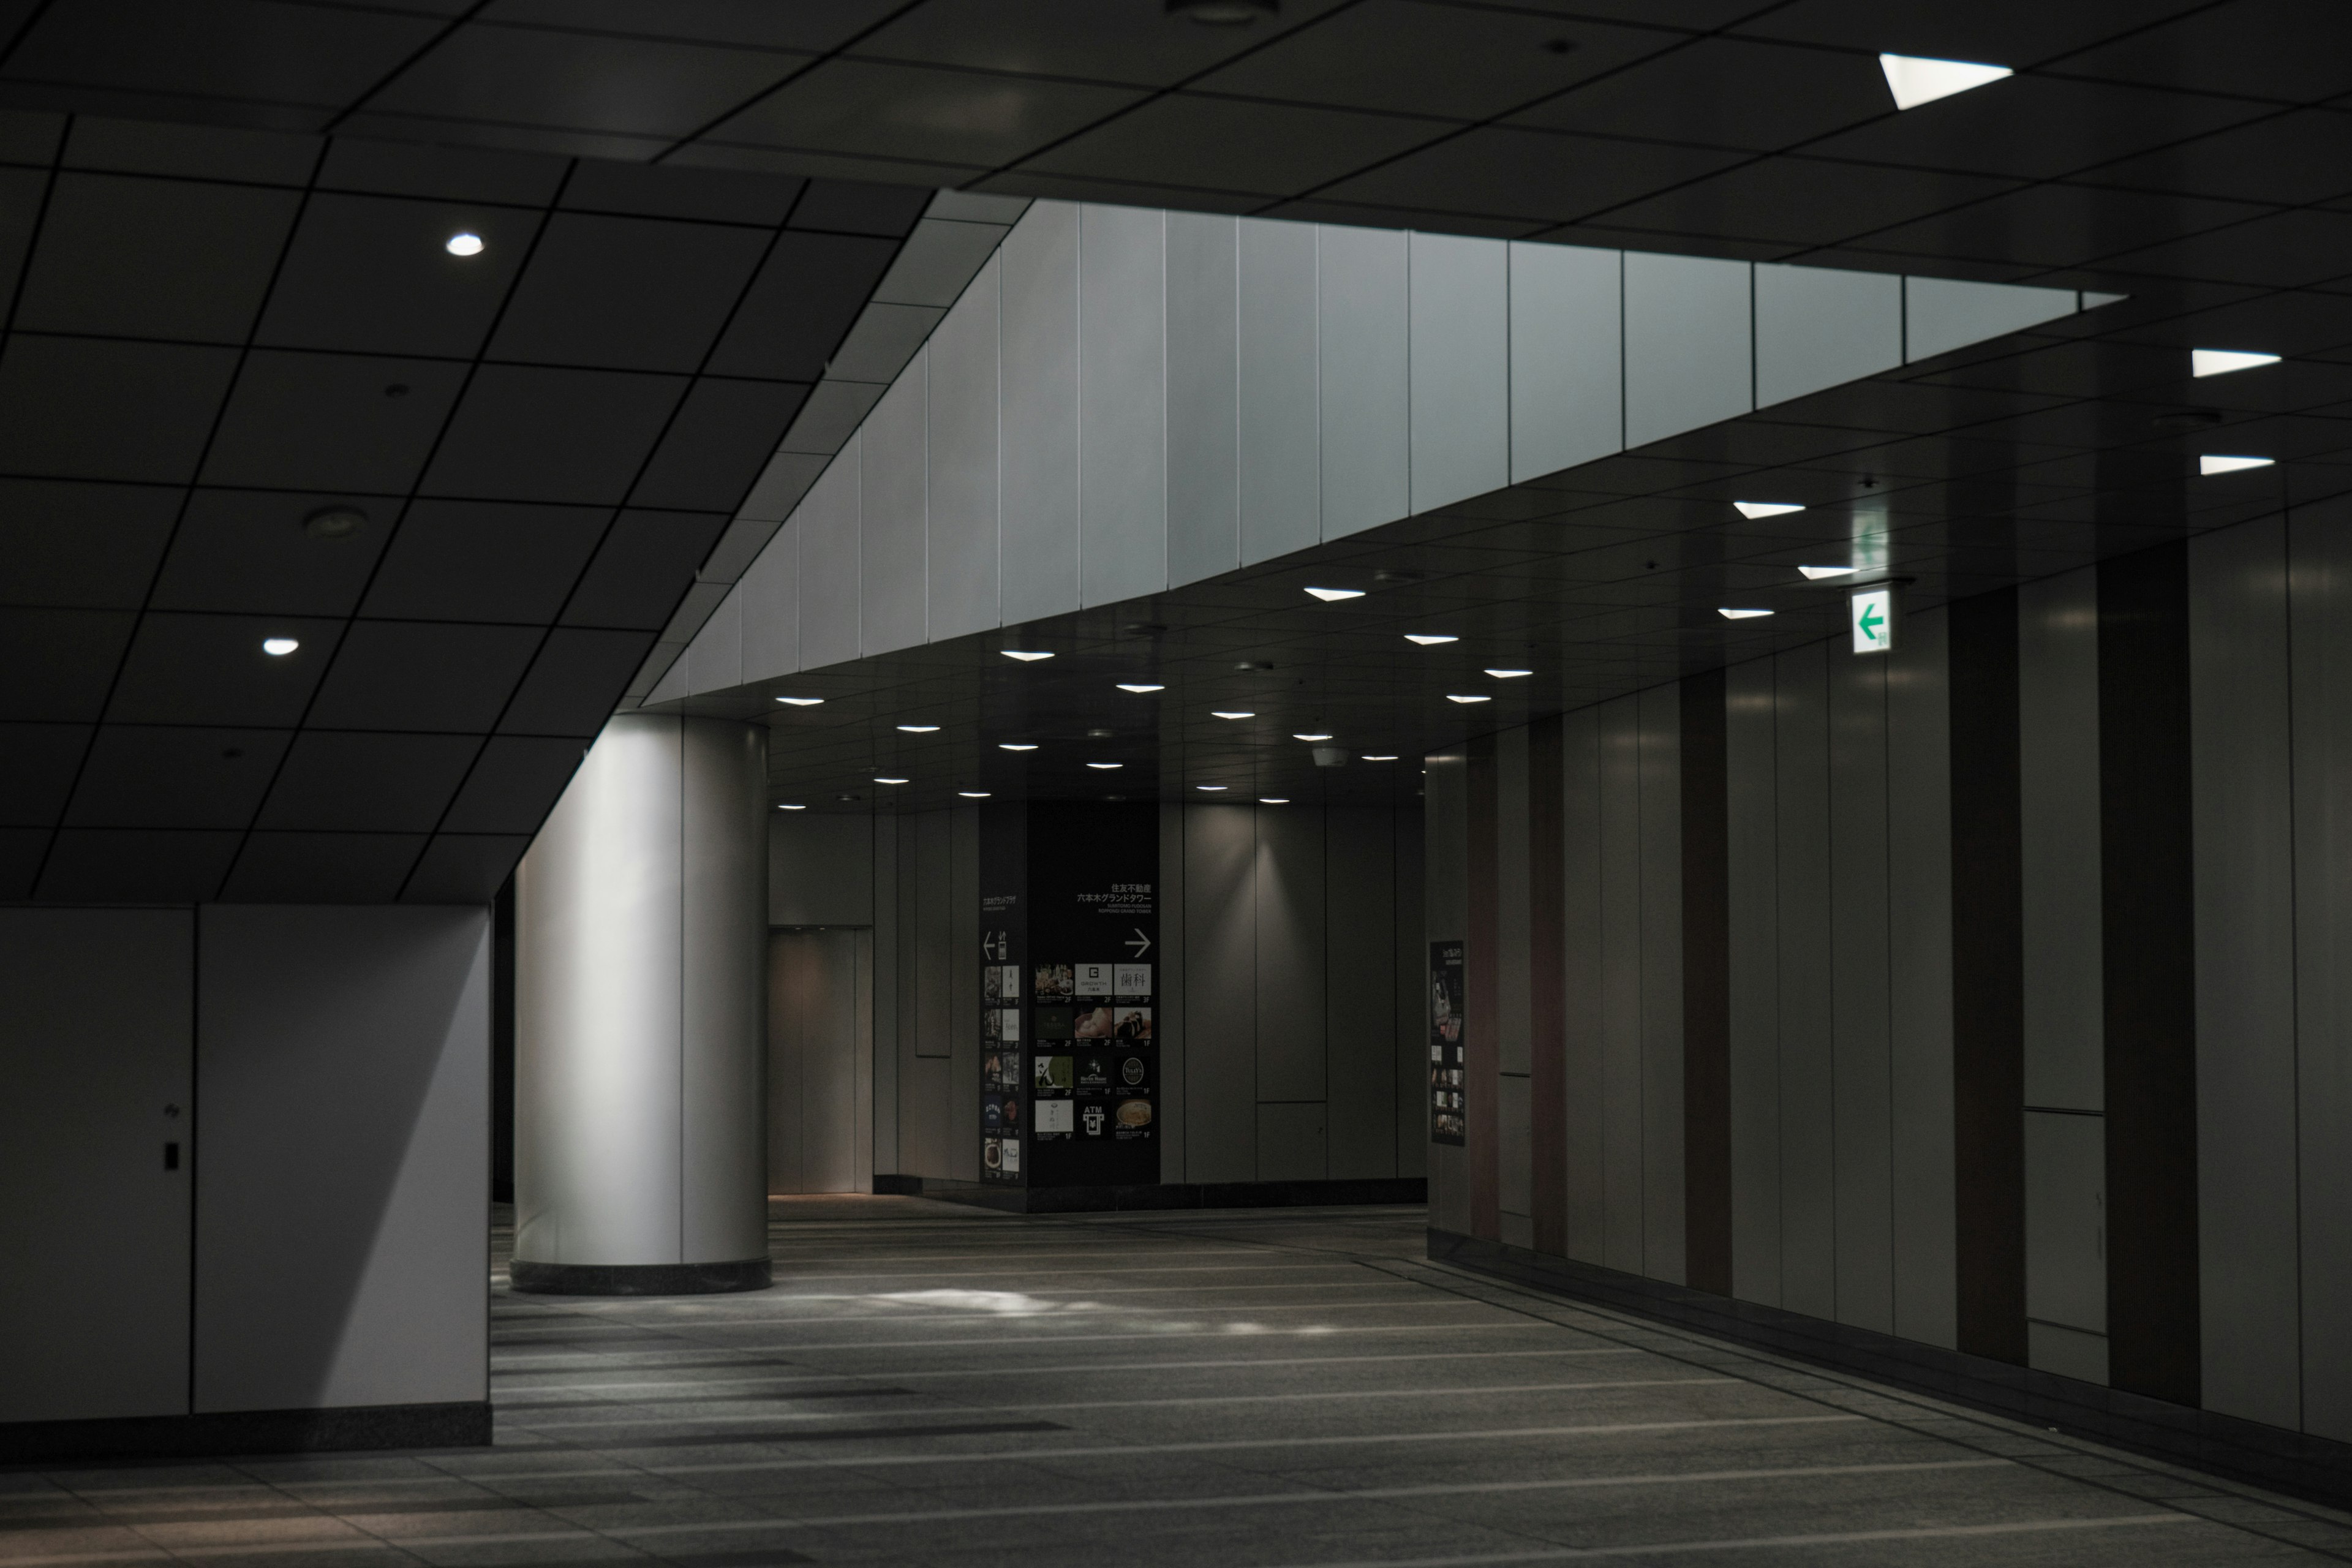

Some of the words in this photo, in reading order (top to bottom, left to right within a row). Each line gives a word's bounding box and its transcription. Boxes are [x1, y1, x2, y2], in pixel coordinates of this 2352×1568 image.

[1111, 883, 1152, 893] 住友不動産
[1077, 893, 1152, 903] 六本木グランドタワー
[1121, 973, 1145, 987] 歯科
